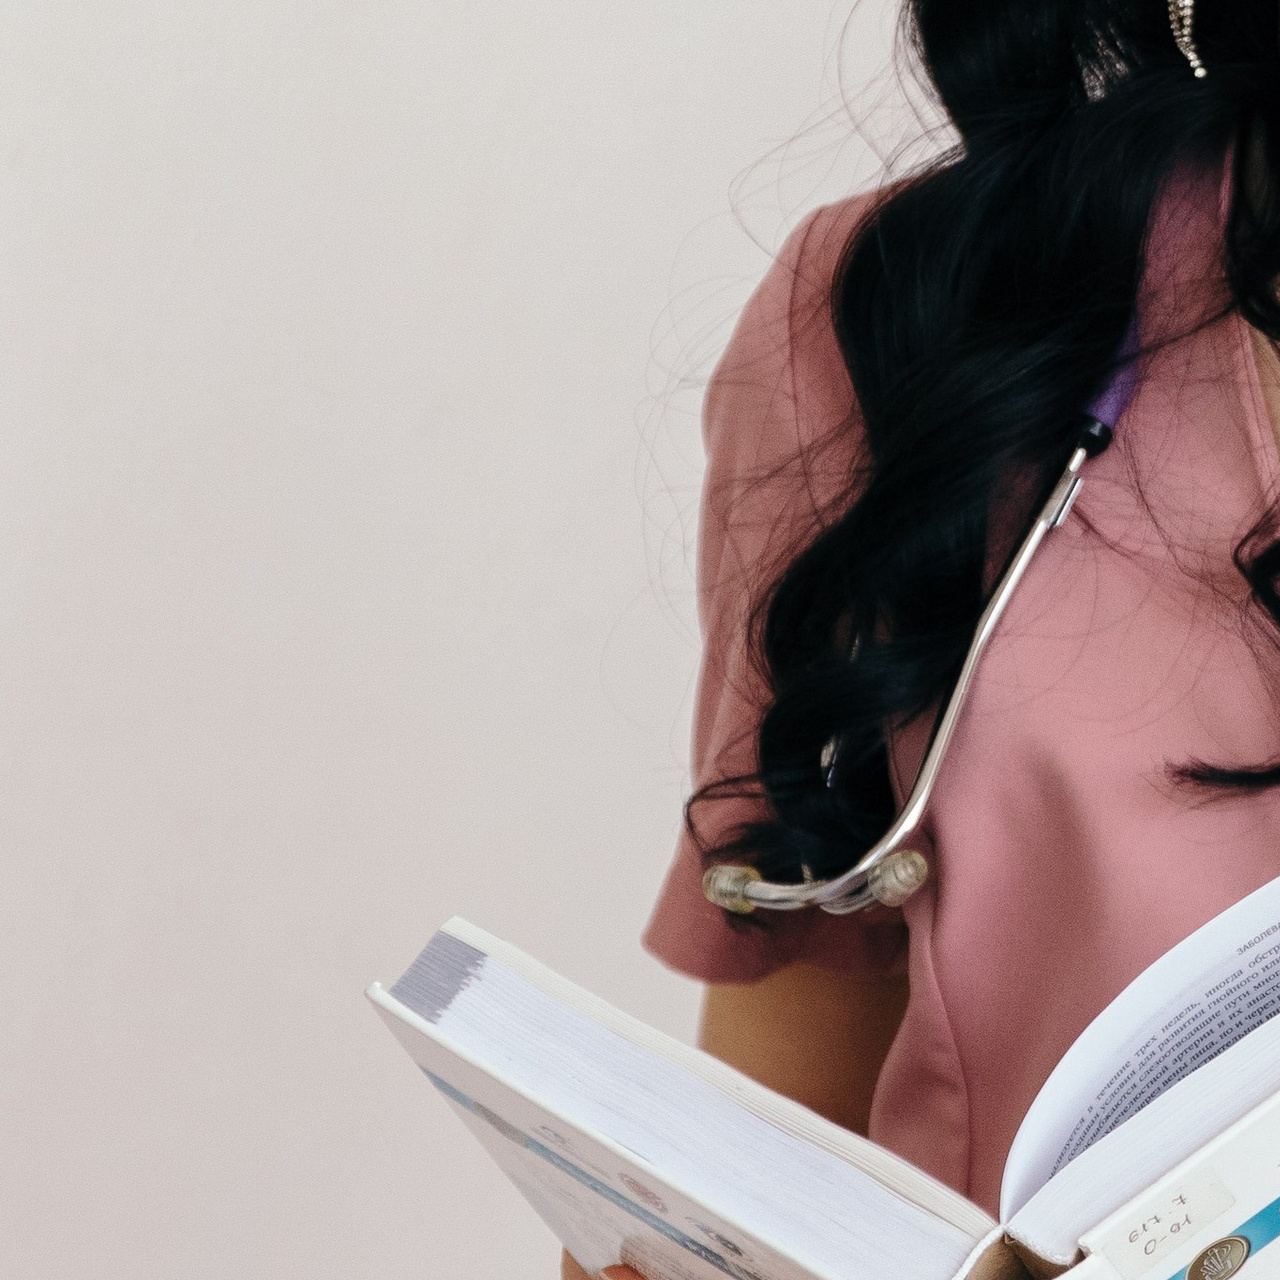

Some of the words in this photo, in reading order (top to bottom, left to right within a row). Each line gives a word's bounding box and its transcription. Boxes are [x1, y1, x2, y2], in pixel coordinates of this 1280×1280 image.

[1067, 1111, 1100, 1162] создавая
[1100, 1069, 1137, 1113] условия
[1138, 1050, 1156, 1071] для
[1157, 1009, 1205, 1052] развития
[1207, 972, 1259, 1010] гнойного
[1095, 1060, 1131, 1102] течение
[1134, 1035, 1158, 1058] трех
[1161, 1002, 1201, 1034] недель,
[1205, 969, 1244, 999] иногда
[1138, 1009, 1221, 1082] слезоотводящие
[1224, 990, 1251, 1011] пути
[1161, 1061, 1188, 1088] вены
[1189, 1040, 1219, 1065] лица,
[1219, 1027, 1234, 1041] но
[1236, 1020, 1244, 1030] и
[1244, 998, 1275, 1023] через
[1172, 1028, 1215, 1067] артерии
[1217, 1020, 1226, 1030] и
[1228, 1009, 1243, 1022] их
